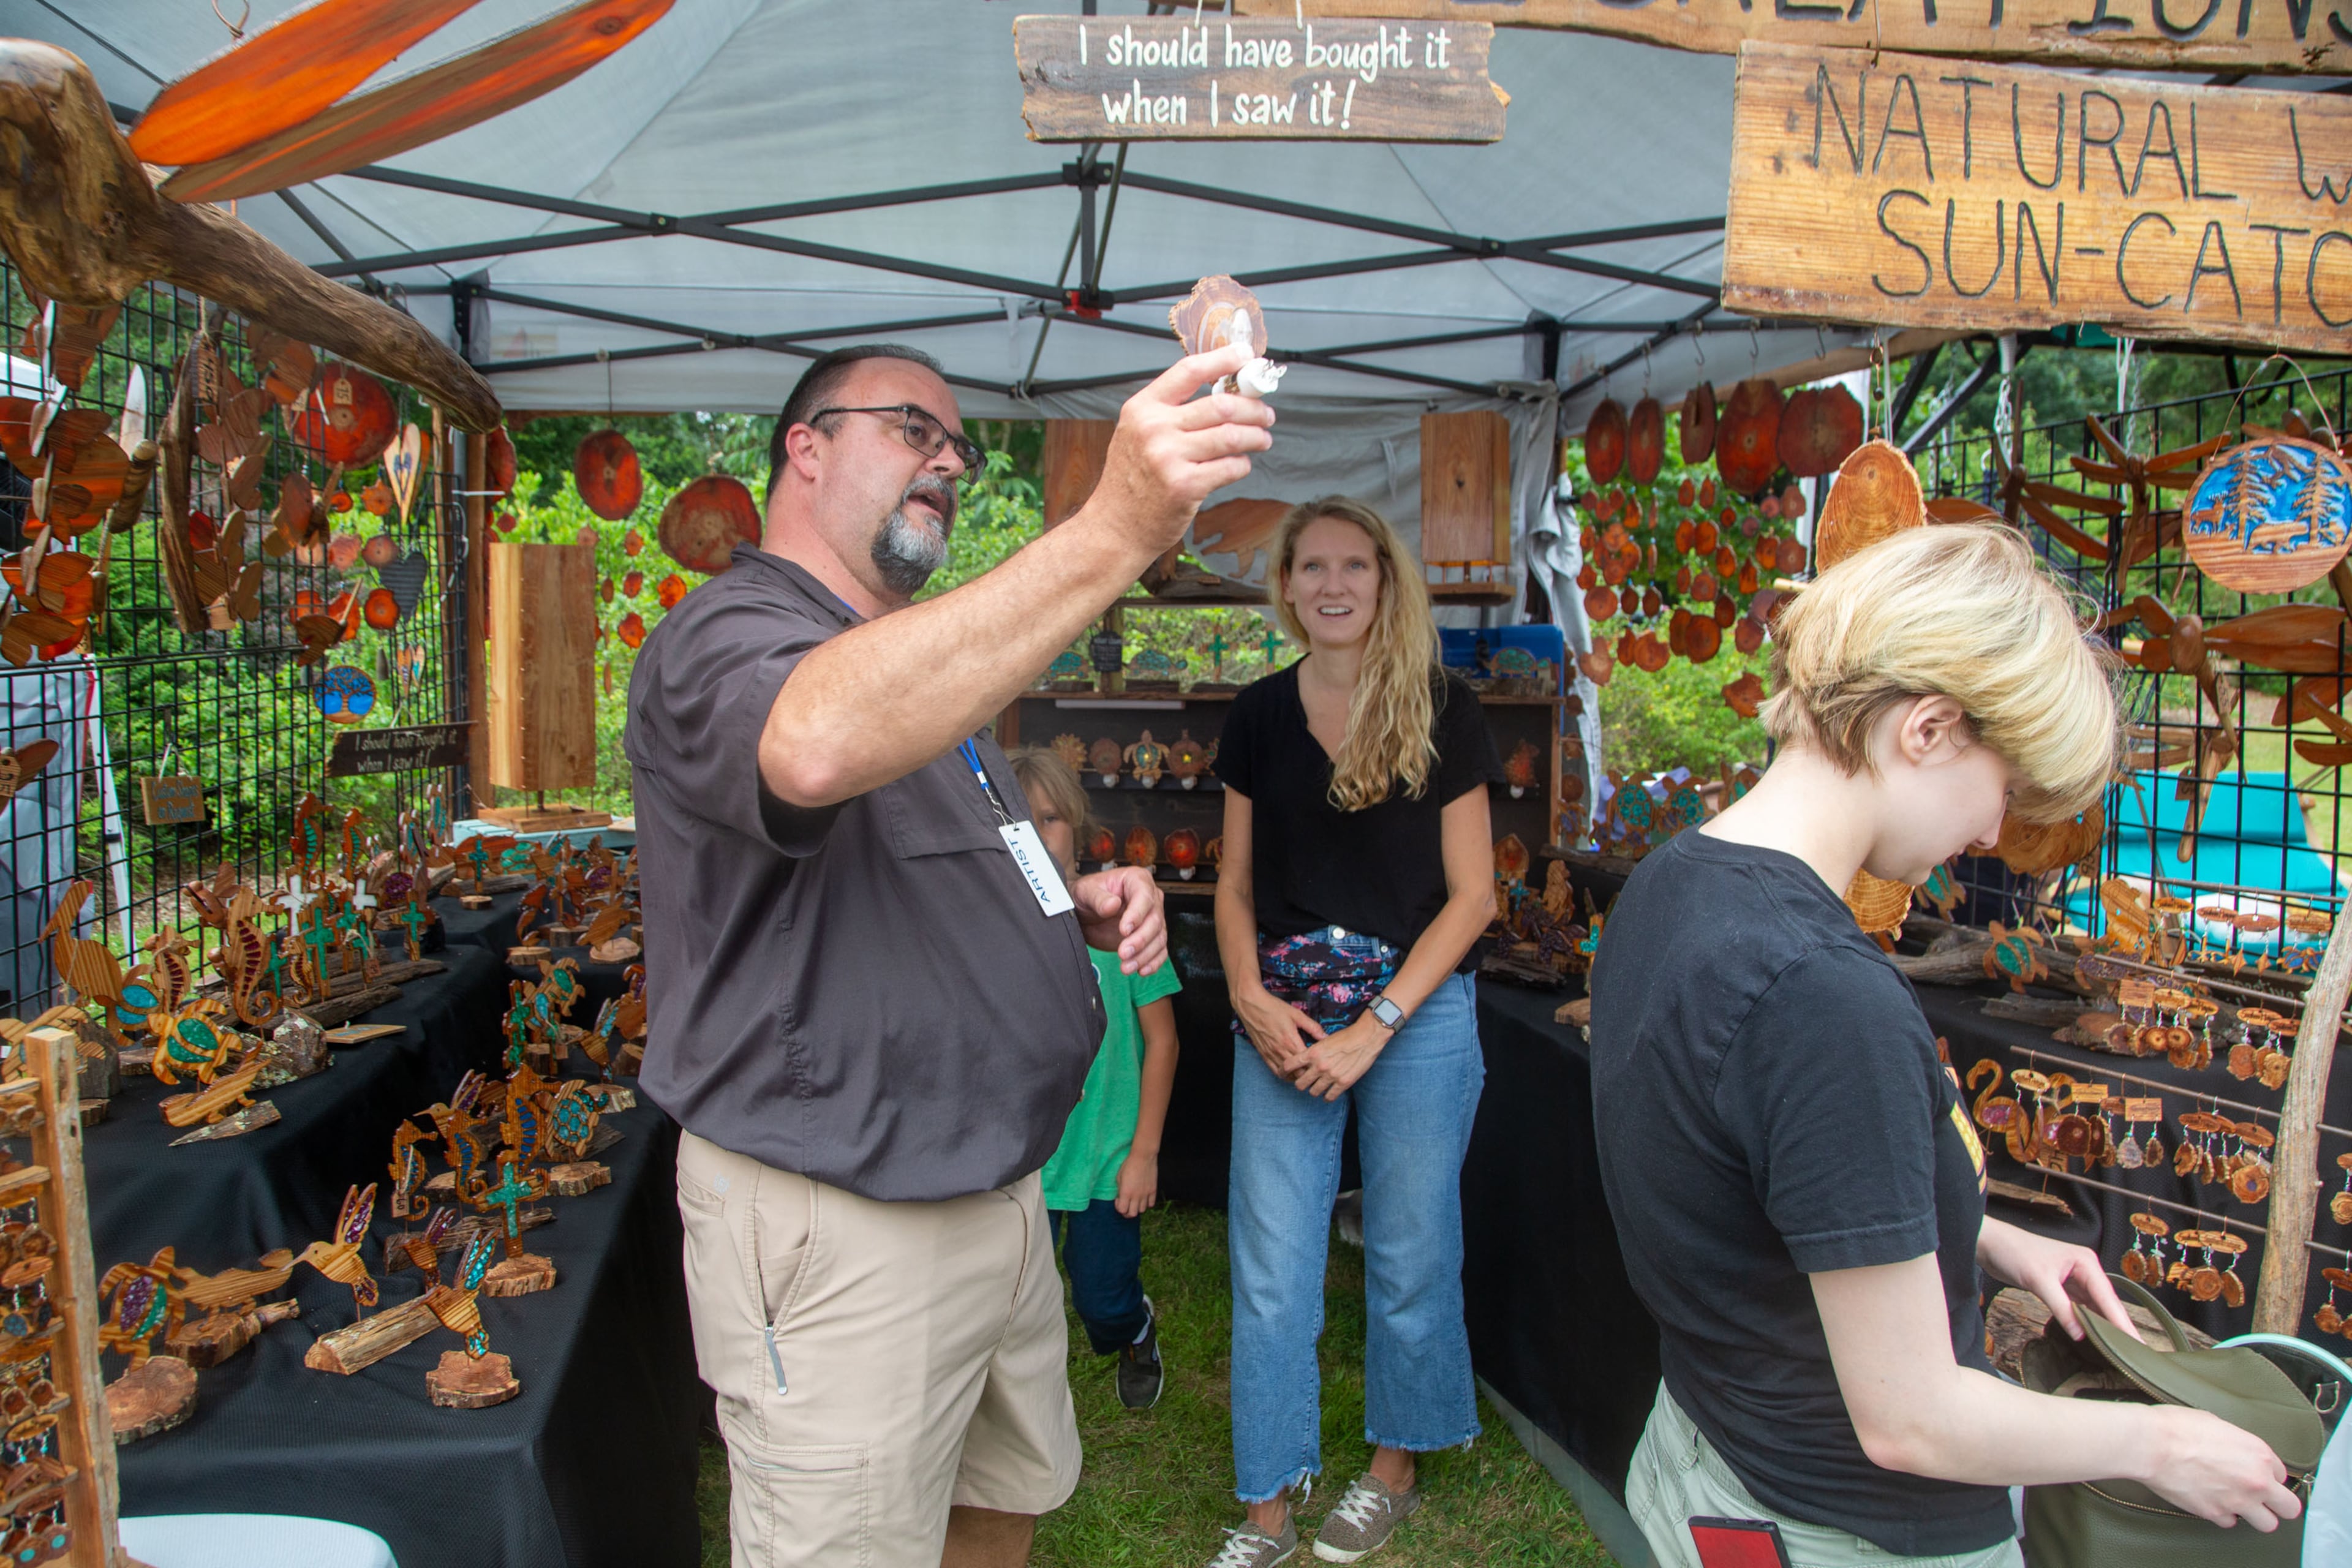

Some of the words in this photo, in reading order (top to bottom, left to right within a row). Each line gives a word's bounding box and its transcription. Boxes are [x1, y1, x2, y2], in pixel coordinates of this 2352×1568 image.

[1079, 23, 1087, 66] I
[1106, 24, 1208, 67] should
[1224, 23, 1293, 68] have
[1305, 24, 1412, 84] bought
[1425, 28, 1450, 69] it
[1102, 78, 1187, 126] when
[1210, 79, 1219, 127] I
[1231, 91, 1298, 125] saw
[1309, 79, 1357, 130] it!
[1812, 64, 2237, 202] NATURAL
[355, 734, 360, 752] I
[361, 733, 391, 751] should
[393, 732, 415, 748] have
[417, 729, 447, 750] bought
[448, 728, 457, 745] it
[357, 754, 383, 772] when
[393, 756, 413, 771] saw
[415, 748, 431, 768] it!
[1008, 837, 1051, 903] ARTIST
